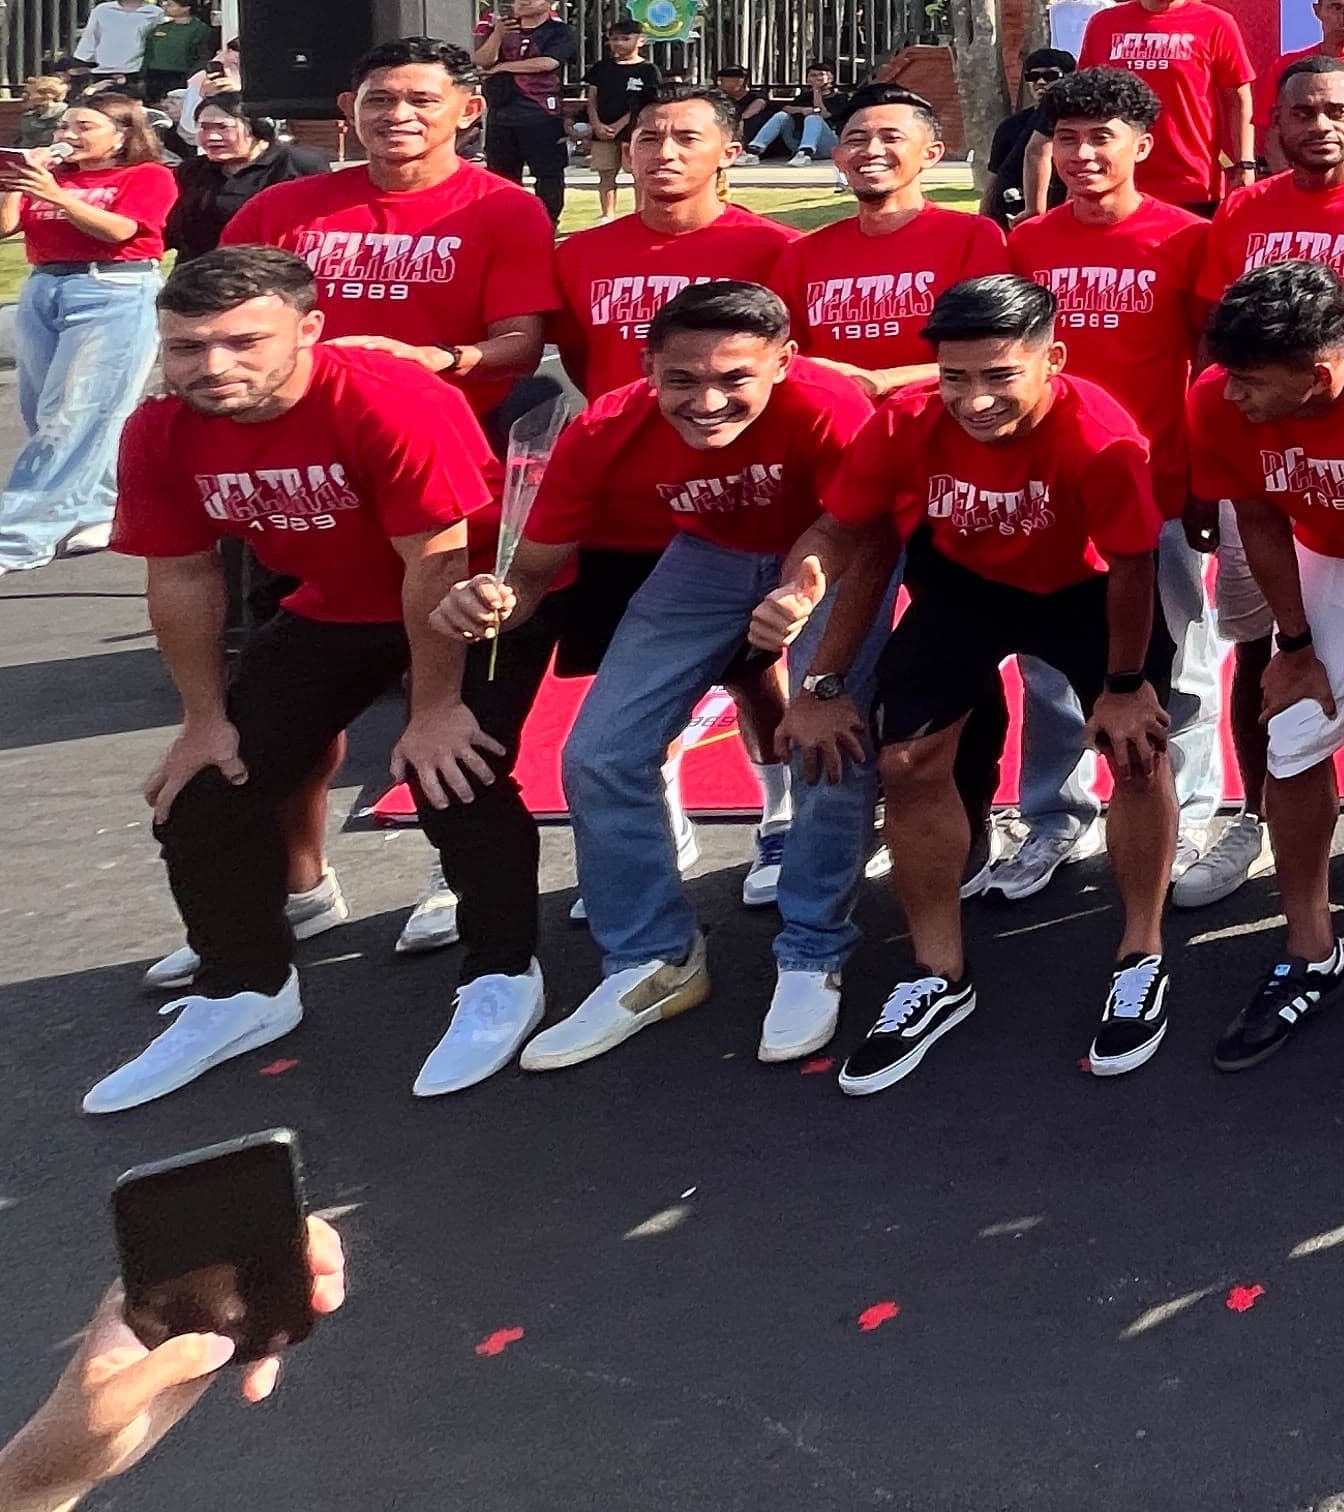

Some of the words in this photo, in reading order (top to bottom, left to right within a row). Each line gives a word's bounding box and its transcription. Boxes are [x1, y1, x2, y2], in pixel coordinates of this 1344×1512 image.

[325, 283, 409, 300] 1989
[808, 271, 935, 326] DELTRAS
[831, 320, 899, 340] 1989
[1060, 313, 1119, 328] 1989
[195, 463, 363, 522] DELTRAS
[249, 513, 337, 532] 1989
